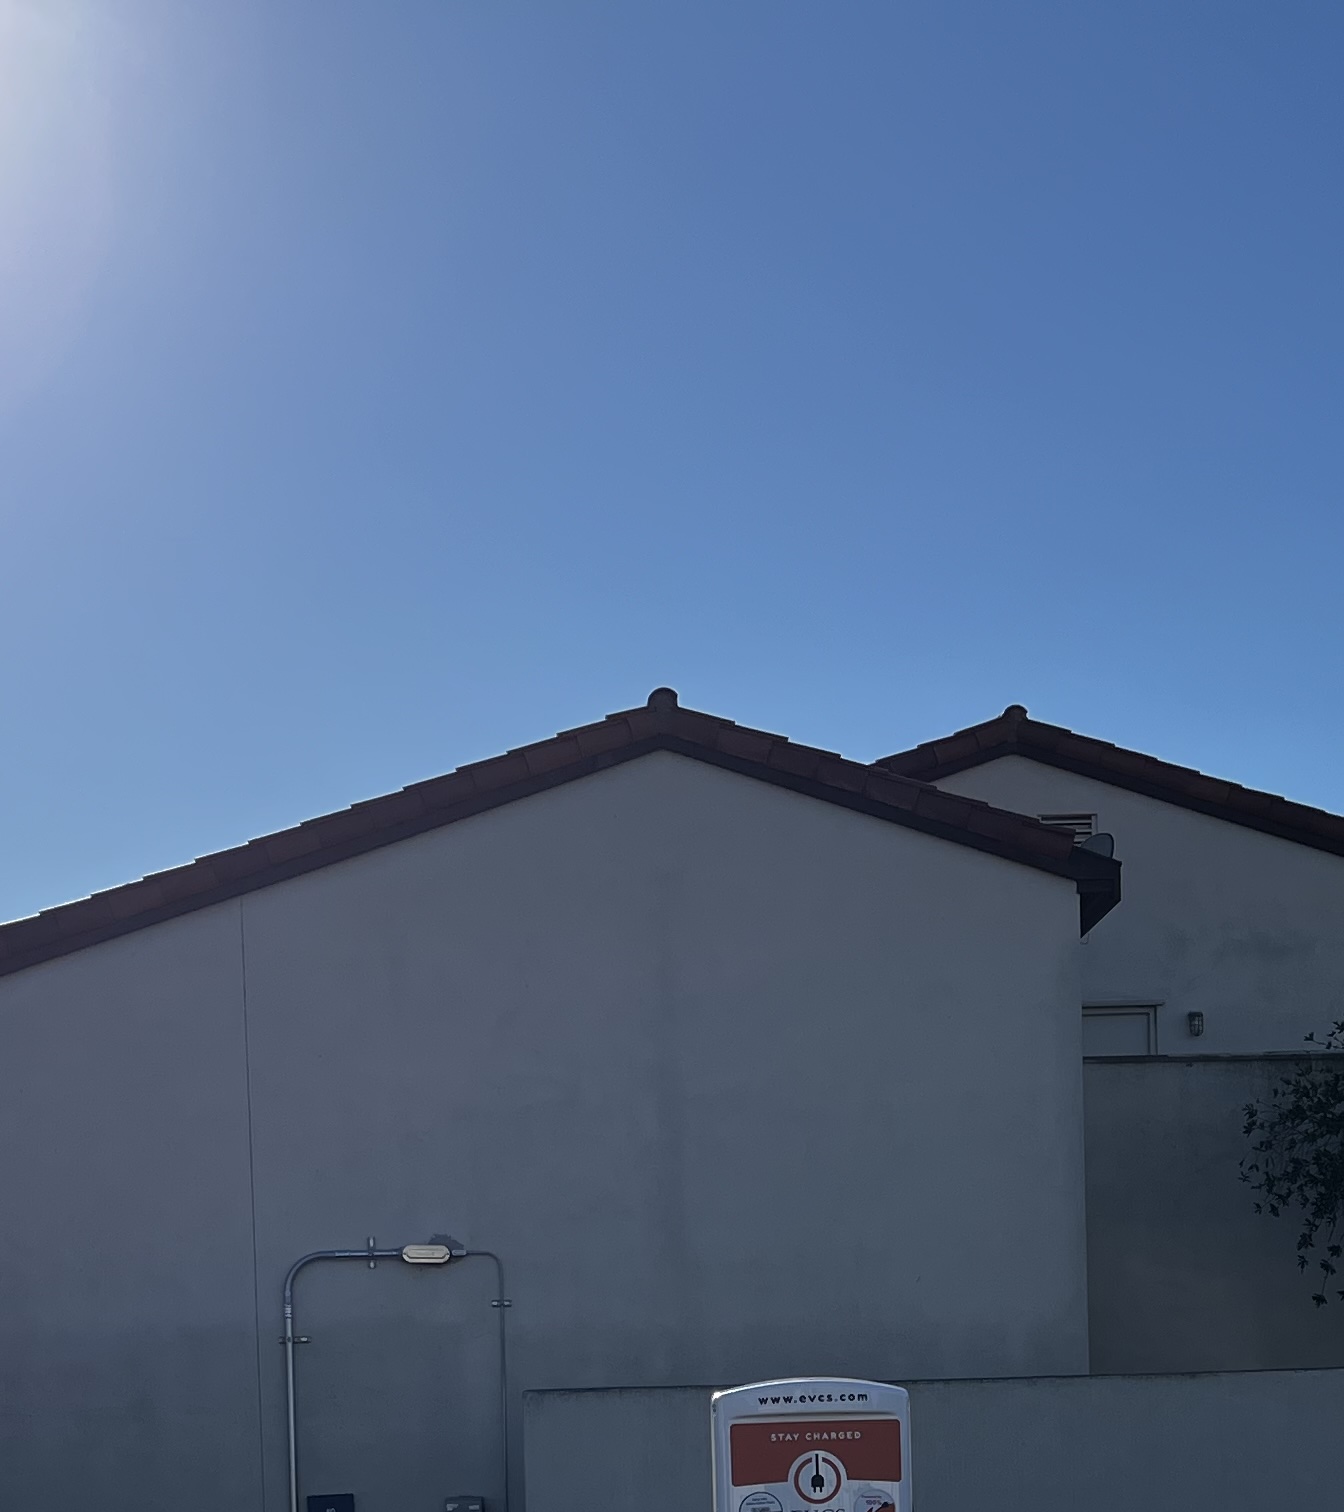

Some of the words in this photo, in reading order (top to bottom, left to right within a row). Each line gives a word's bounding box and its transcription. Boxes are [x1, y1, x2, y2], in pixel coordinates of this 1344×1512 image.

[758, 1392, 869, 1406] www.evcs.com
[770, 1433, 800, 1442] STAY
[805, 1431, 861, 1441] CHARGED
